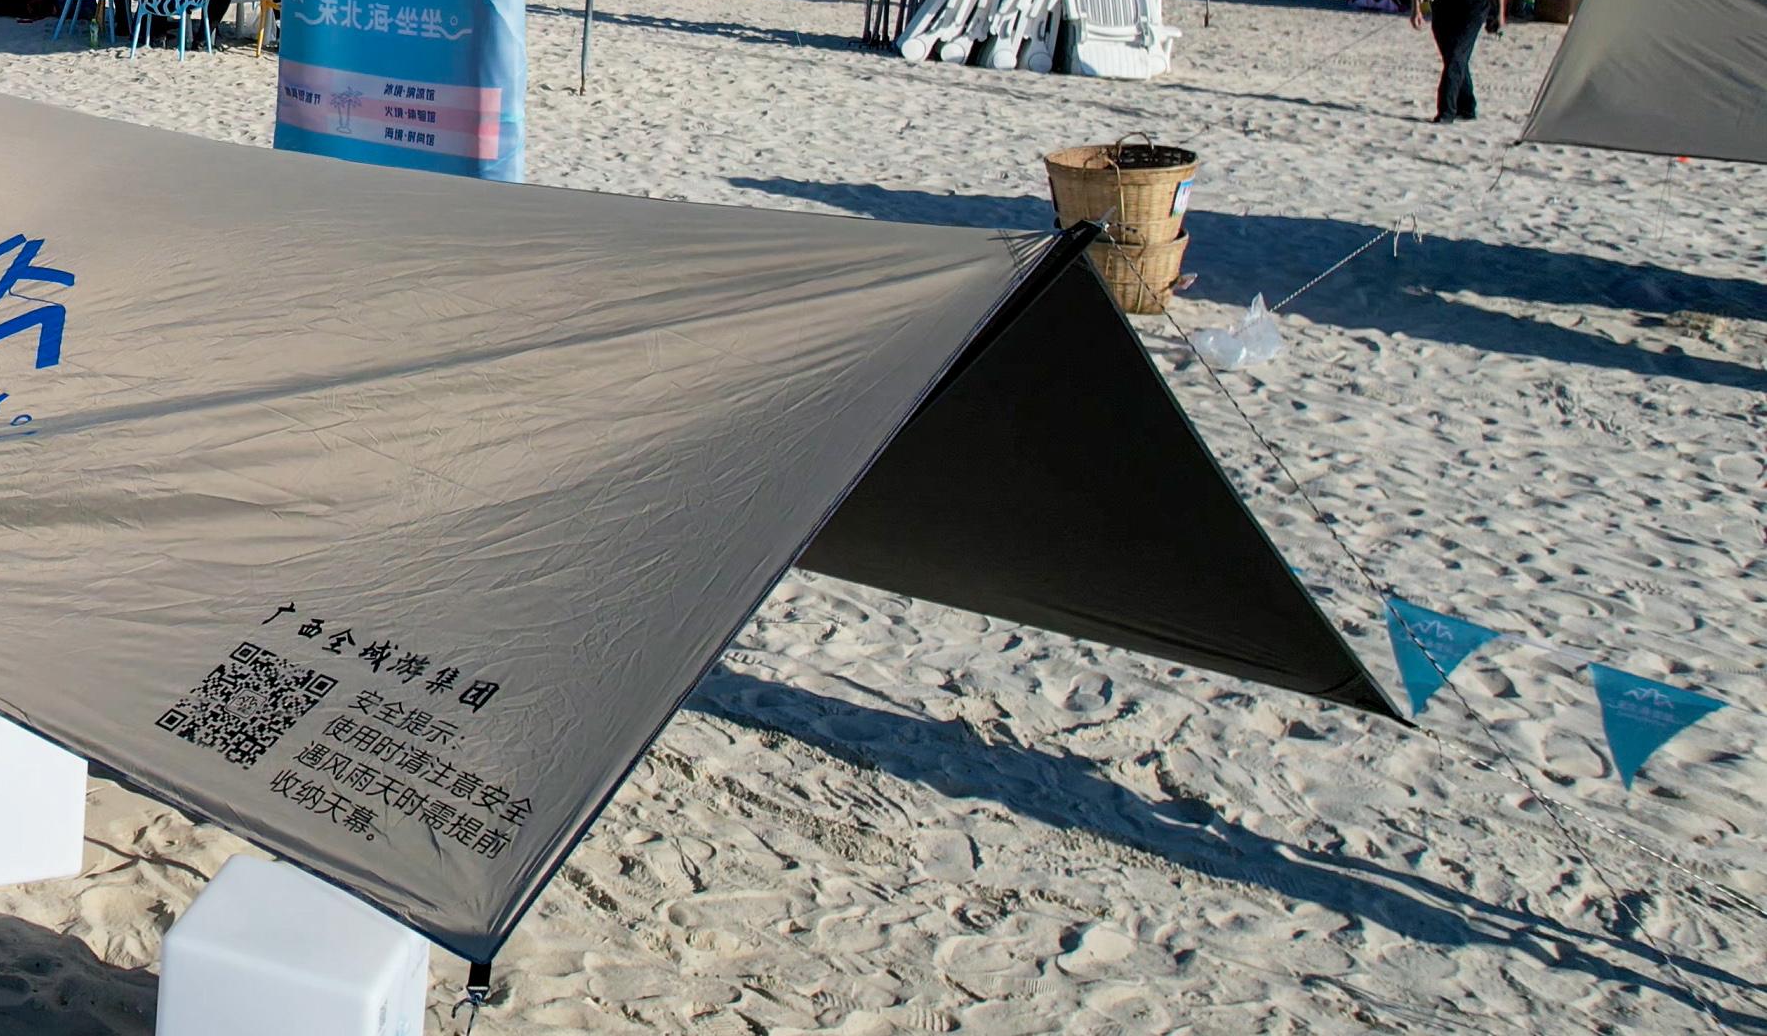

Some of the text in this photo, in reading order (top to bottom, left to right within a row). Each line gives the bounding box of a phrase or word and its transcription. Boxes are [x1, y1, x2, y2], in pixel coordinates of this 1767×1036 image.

[260, 601, 501, 714] 广西全域游集团
[269, 769, 376, 842] 收纳天幕。
[292, 740, 512, 860] 遇风雨天时需提前
[321, 714, 534, 827] 使用时请注意安全
